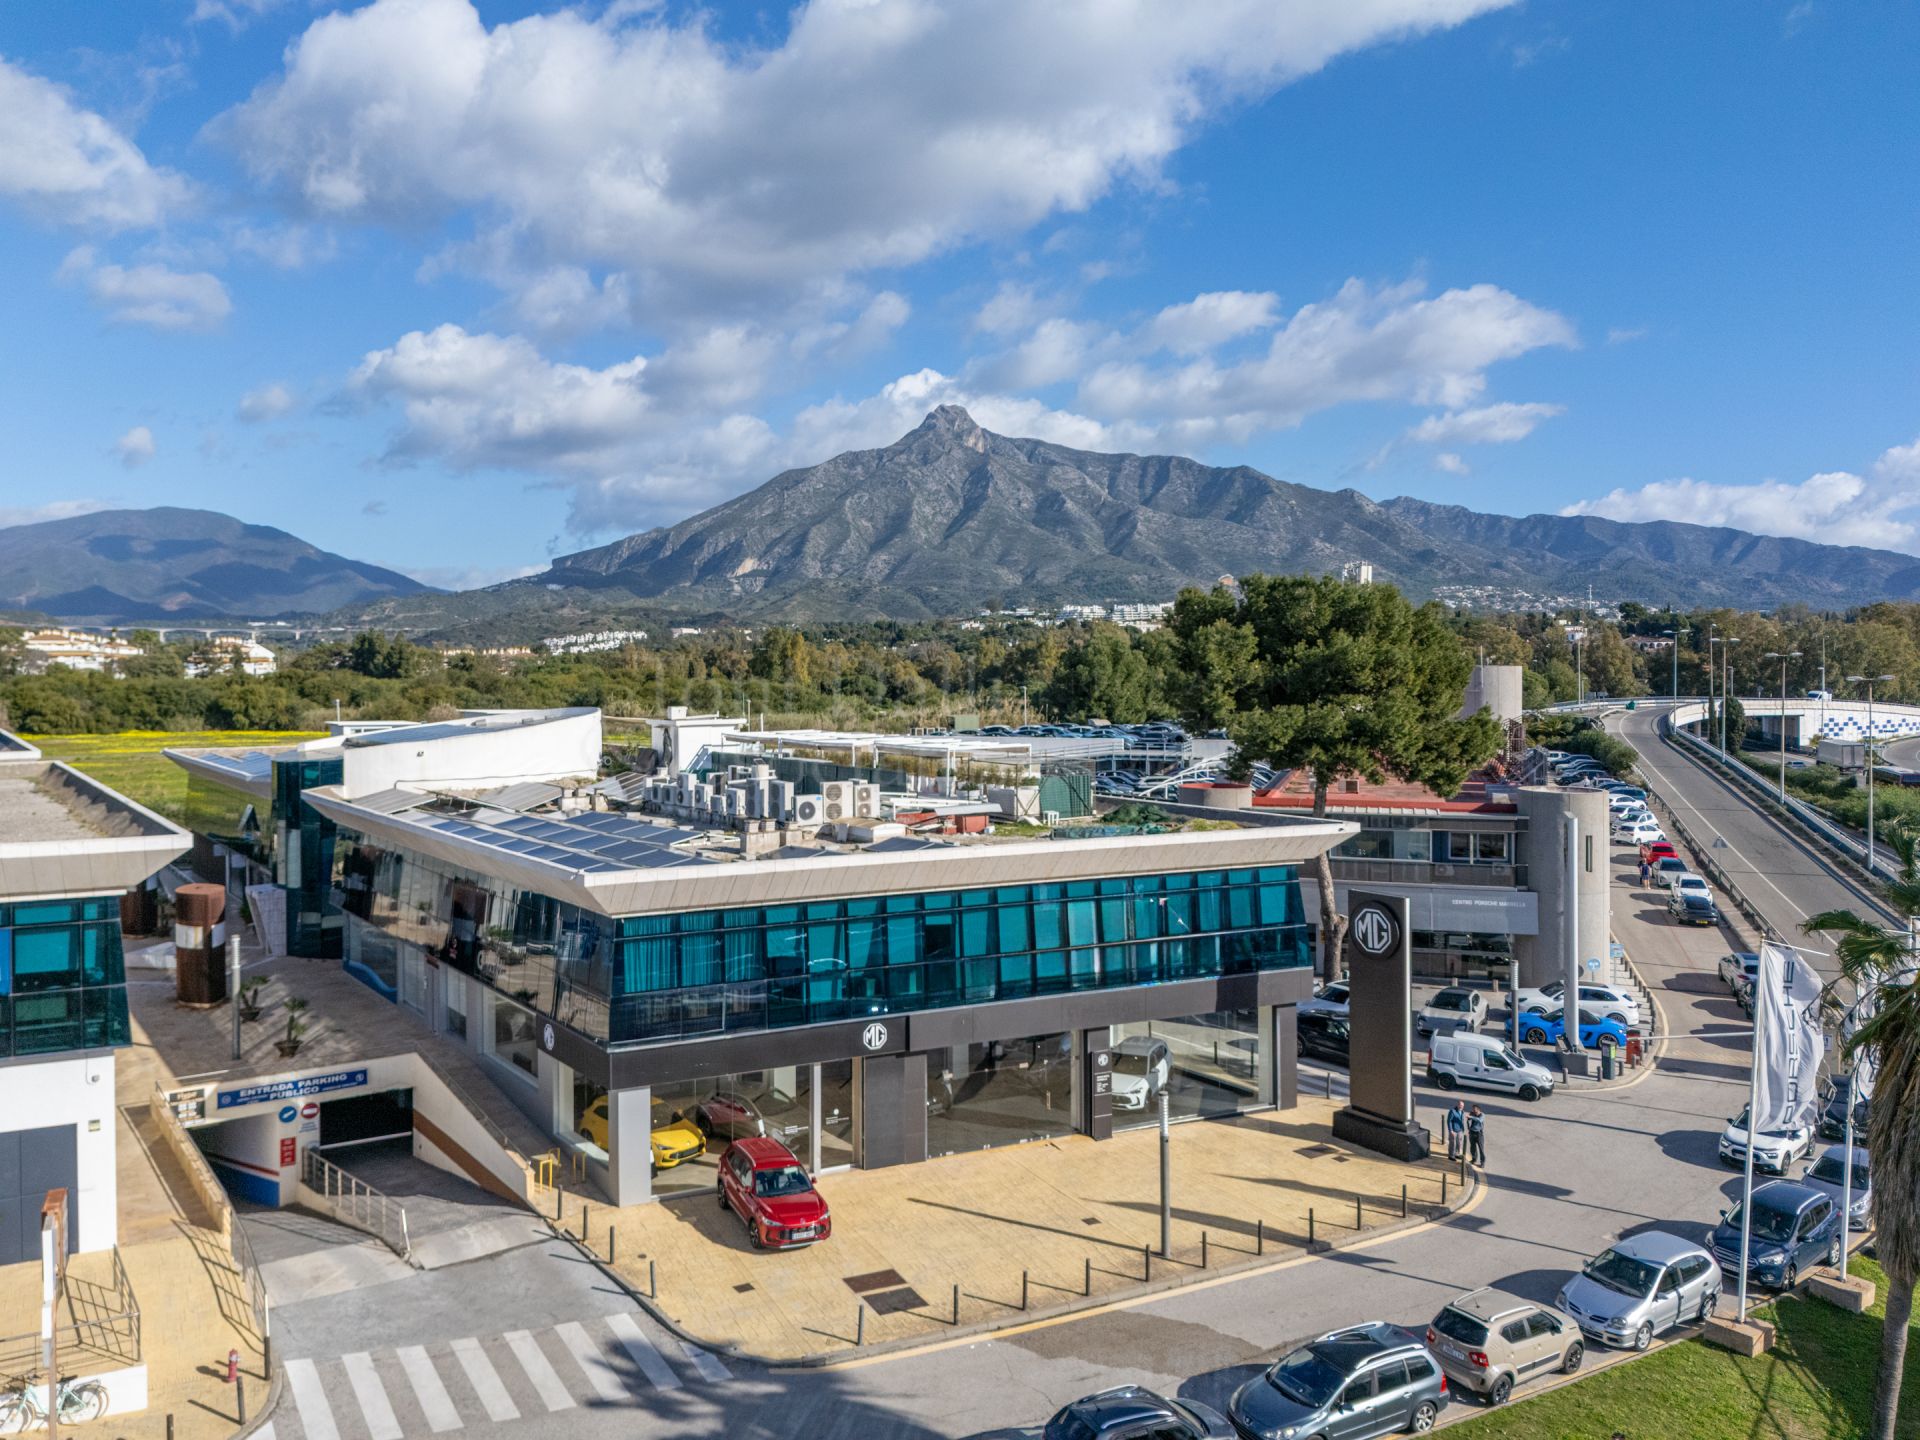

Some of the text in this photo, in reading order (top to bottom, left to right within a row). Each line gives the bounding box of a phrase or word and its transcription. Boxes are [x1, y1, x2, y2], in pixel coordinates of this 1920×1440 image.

[1357, 911, 1389, 951] MG
[865, 1025, 886, 1048] MG
[239, 1082, 294, 1098] ENTRADA
[297, 1073, 347, 1088] PARKING
